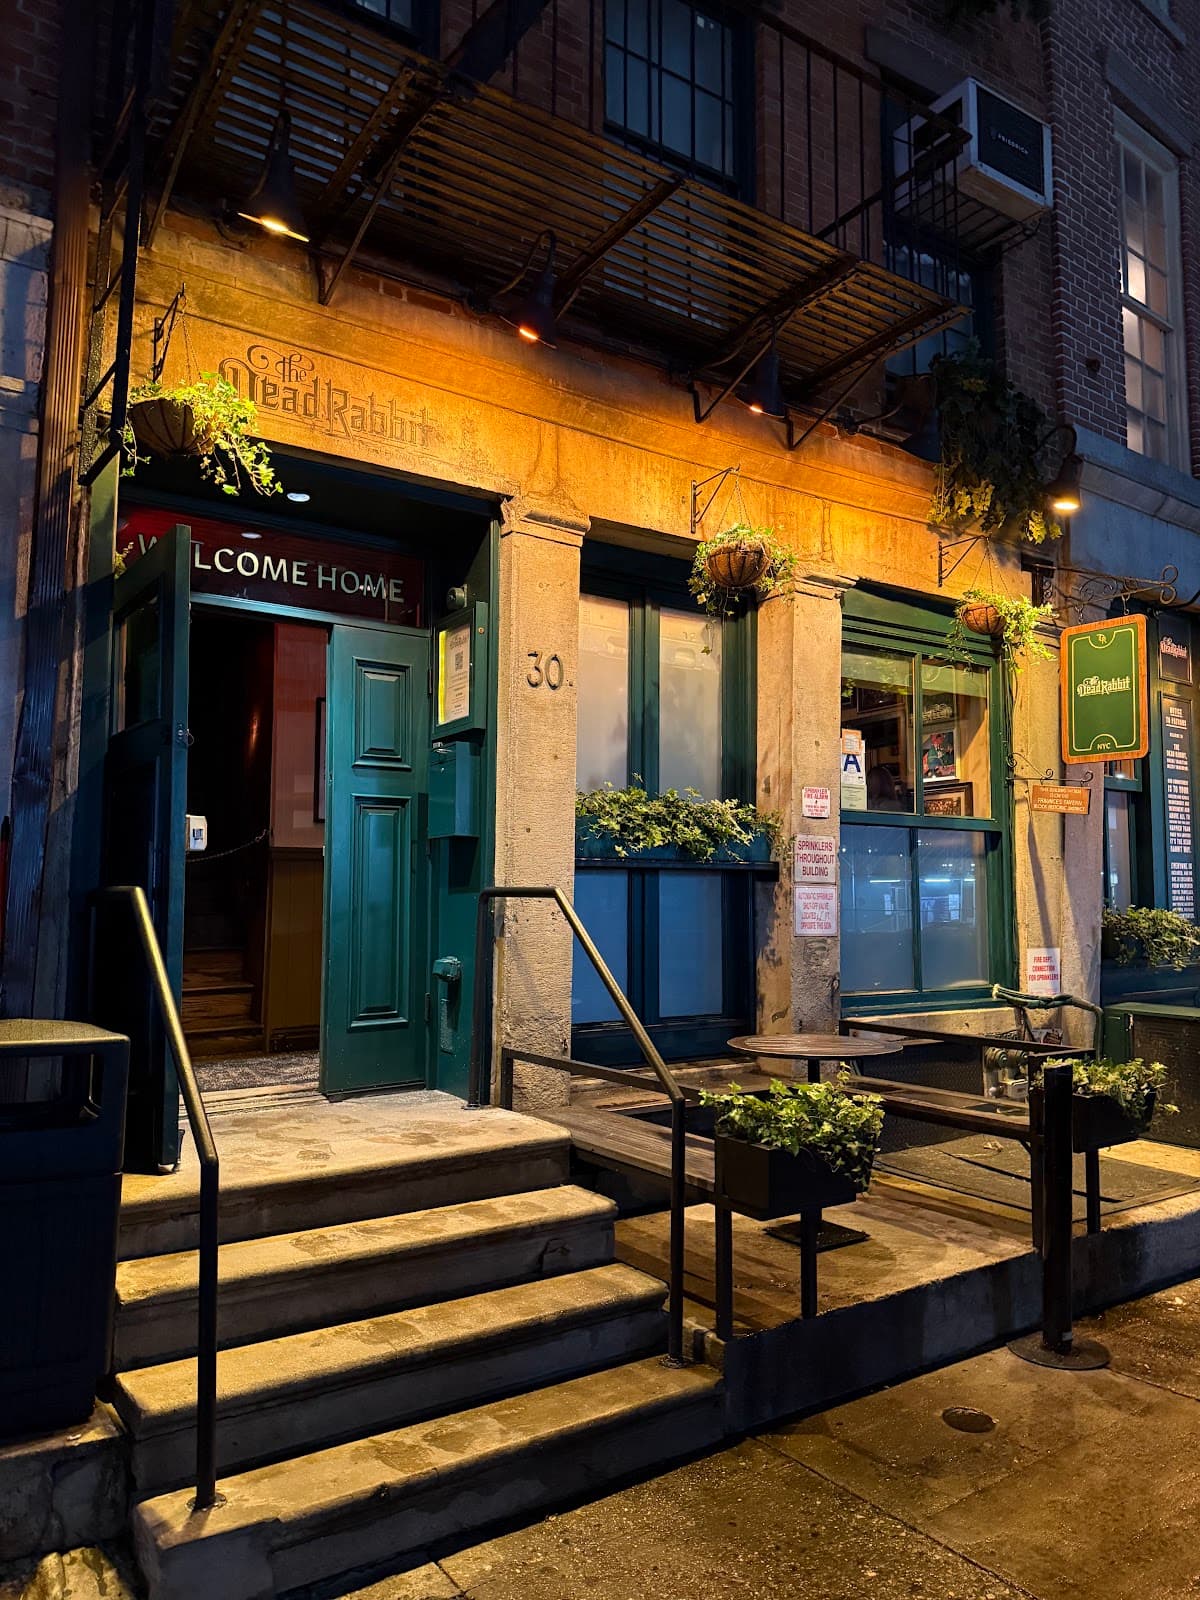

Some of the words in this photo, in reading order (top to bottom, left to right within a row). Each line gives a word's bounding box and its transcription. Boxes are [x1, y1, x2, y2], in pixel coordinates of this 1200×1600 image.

[325, 379, 436, 446] Rabbit
[138, 534, 309, 586] LCOME
[317, 565, 404, 602] HOME
[527, 651, 564, 691] 30
[1077, 680, 1101, 697] Dead
[1101, 675, 1131, 695] Rabbit
[1097, 742, 1111, 750] NYC
[843, 753, 861, 773] A
[797, 840, 833, 852] SPRINKLERS
[796, 853, 835, 865] THROUGHOUT
[802, 866, 829, 877] BUILDING
